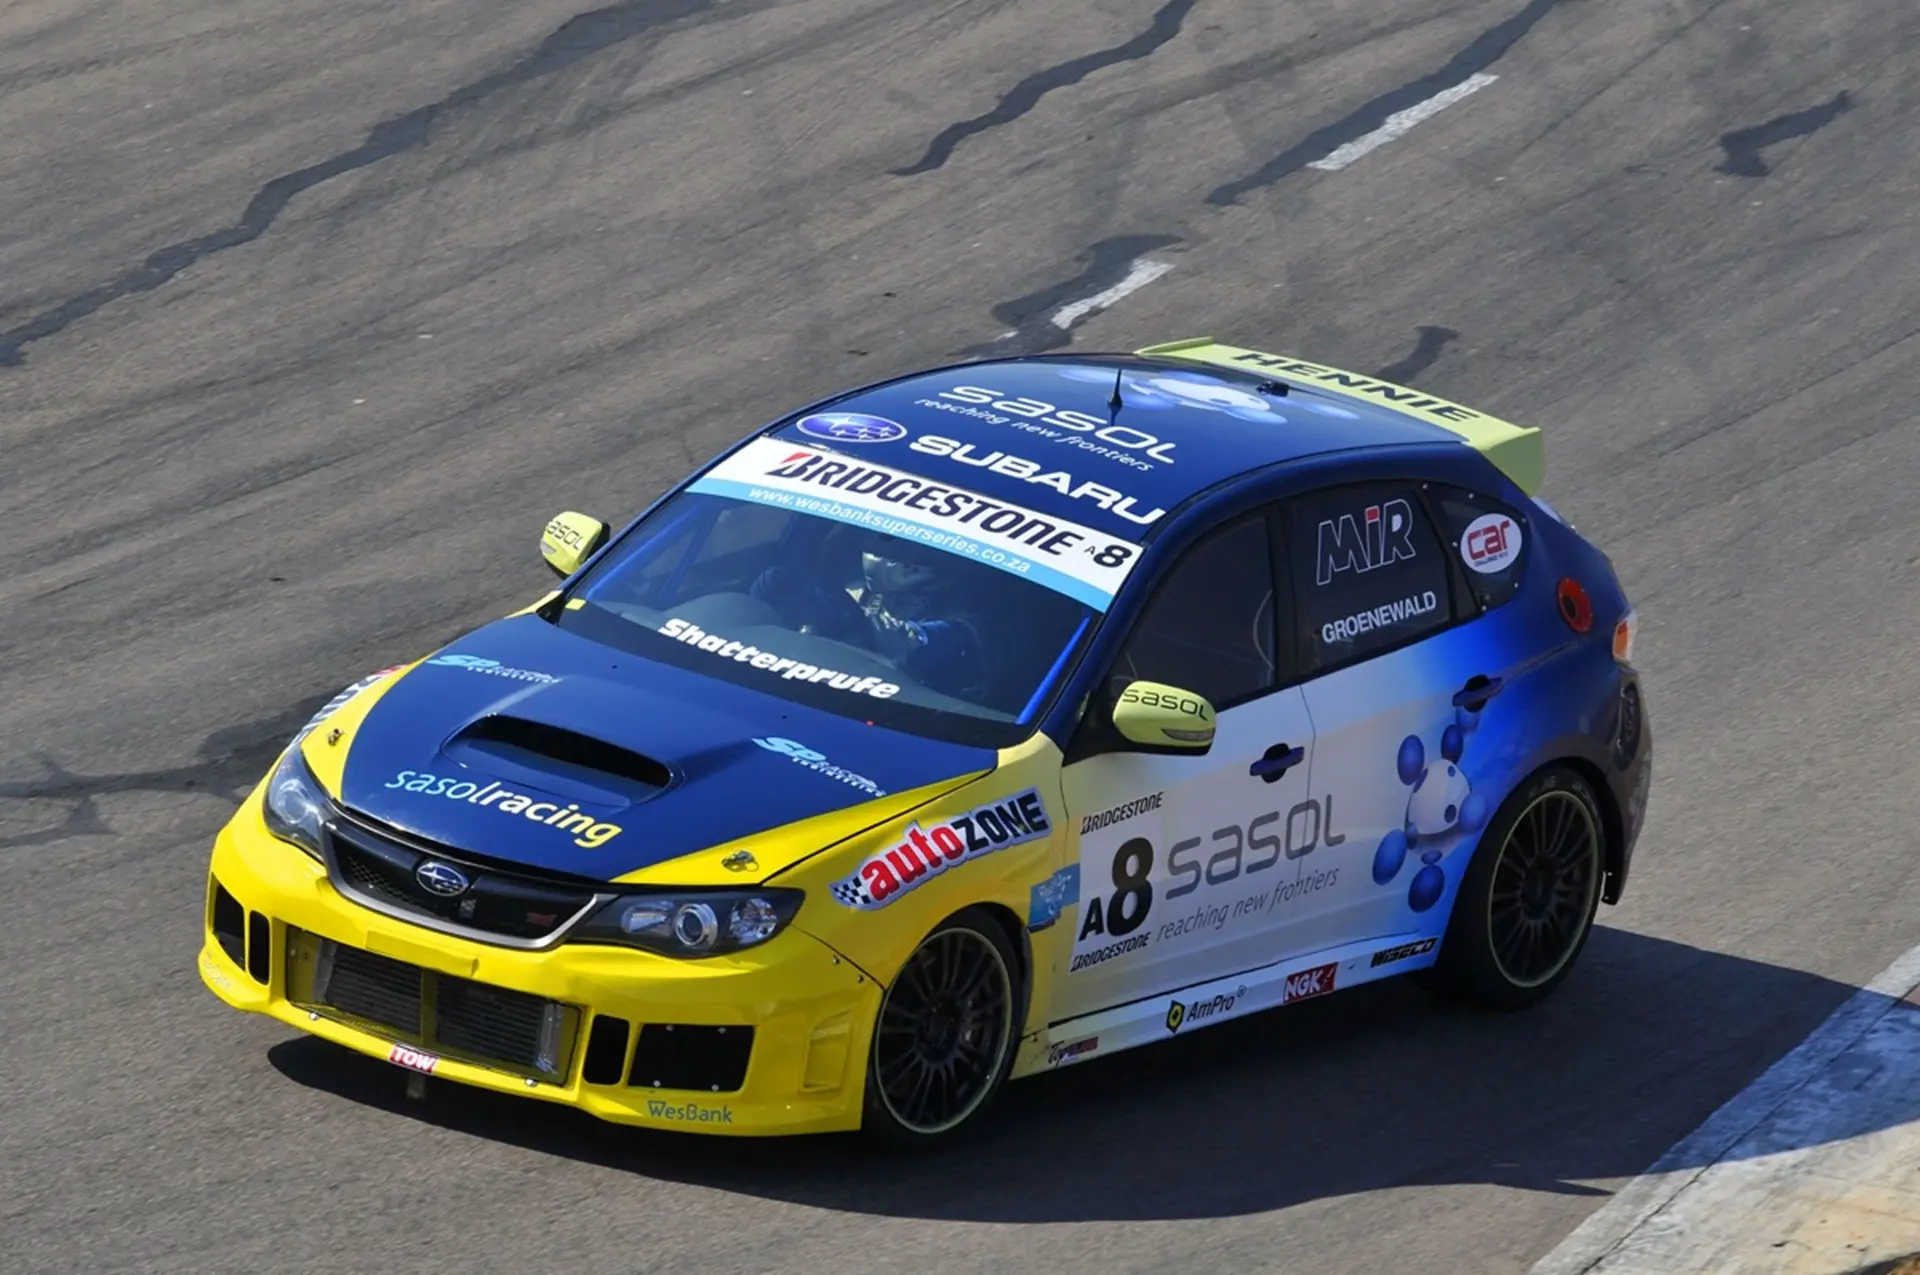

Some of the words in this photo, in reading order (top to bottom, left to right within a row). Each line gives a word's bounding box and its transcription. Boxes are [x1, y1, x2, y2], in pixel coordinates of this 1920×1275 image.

[1233, 353, 1480, 422] HENNIE
[915, 399, 1010, 425] reaching
[1011, 419, 1061, 438] new
[1055, 434, 1154, 472] frontiers
[765, 452, 1085, 557] BRIDGESTONE
[909, 435, 1166, 525] SUBARU
[748, 486, 1032, 574] www.wesbanksuperseries.co.za
[1467, 520, 1510, 560] car
[1322, 591, 1437, 643] GROENEWALD
[658, 617, 900, 699] Shatterprufe
[384, 769, 624, 849] sasolracing
[1080, 791, 1165, 836] BRIDGESTONE
[861, 791, 1049, 902] autoZONE
[1156, 904, 1230, 943] reaching
[1232, 891, 1270, 918] new
[1267, 867, 1340, 914] frontiers
[1070, 931, 1152, 973] BRIDGESTONE
[1284, 970, 1324, 1001] NGK
[394, 1046, 436, 1070] TOW
[646, 1100, 733, 1124] WesBank
